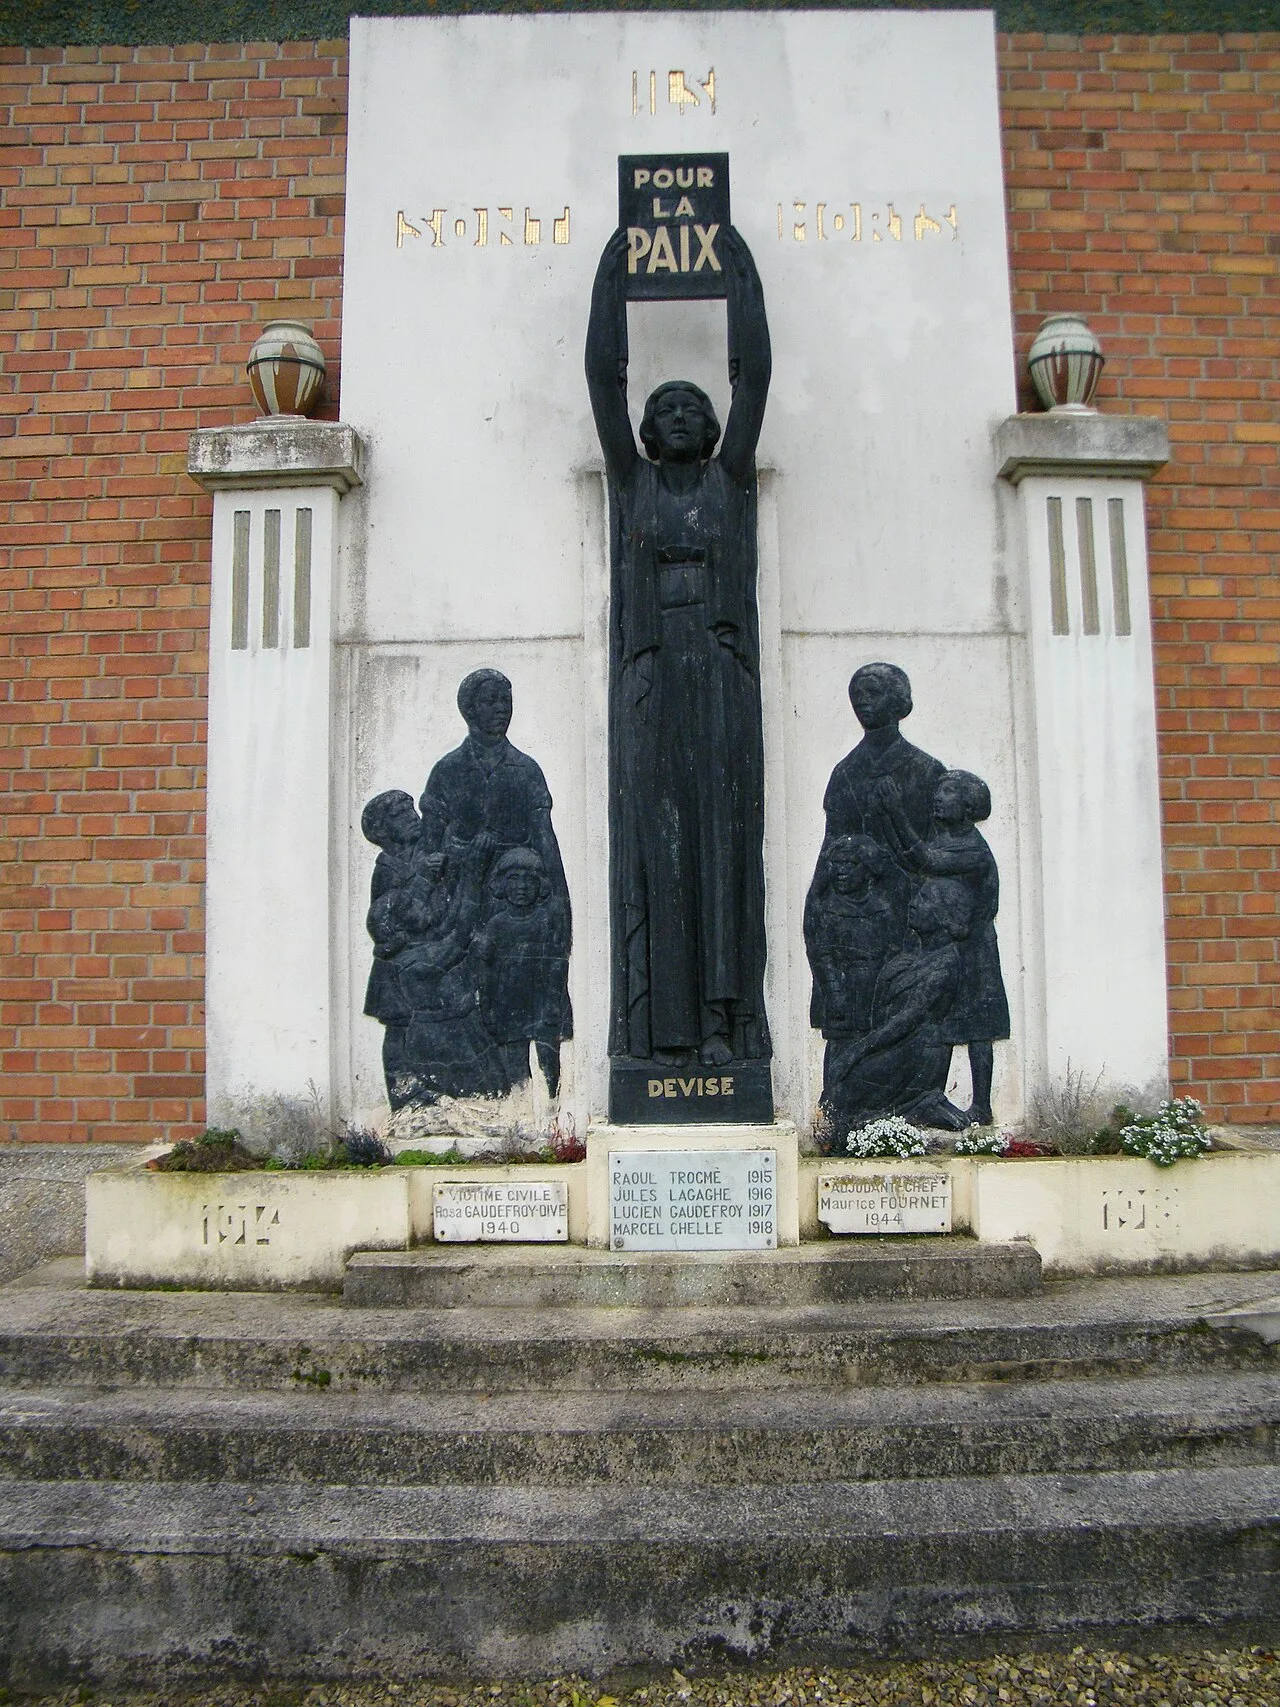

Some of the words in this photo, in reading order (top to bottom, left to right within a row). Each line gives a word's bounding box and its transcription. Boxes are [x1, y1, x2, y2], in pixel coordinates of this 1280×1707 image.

[634, 167, 714, 190] POUR
[653, 196, 695, 218] LA
[627, 223, 722, 275] PAIX
[647, 1077, 734, 1098] DEVISE
[613, 1172, 657, 1185] RAOUL
[747, 1170, 773, 1184] 1915
[447, 1189, 503, 1202] VICTIME
[507, 1189, 551, 1201] CIVILE
[613, 1187, 657, 1202] JULES
[748, 1187, 773, 1200] 1916
[821, 1197, 876, 1210] Maurice
[880, 1195, 949, 1210] FOURNET
[435, 1205, 462, 1218] Rosa
[613, 1203, 662, 1219] LUCIEN
[670, 1204, 744, 1218] GAUDEFROY
[748, 1204, 773, 1217] 1917
[865, 1212, 904, 1226] 1944
[481, 1221, 520, 1234] 1940
[613, 1222, 665, 1236] MARCEL
[670, 1221, 723, 1235] CHELLE
[748, 1221, 774, 1235] 1918
